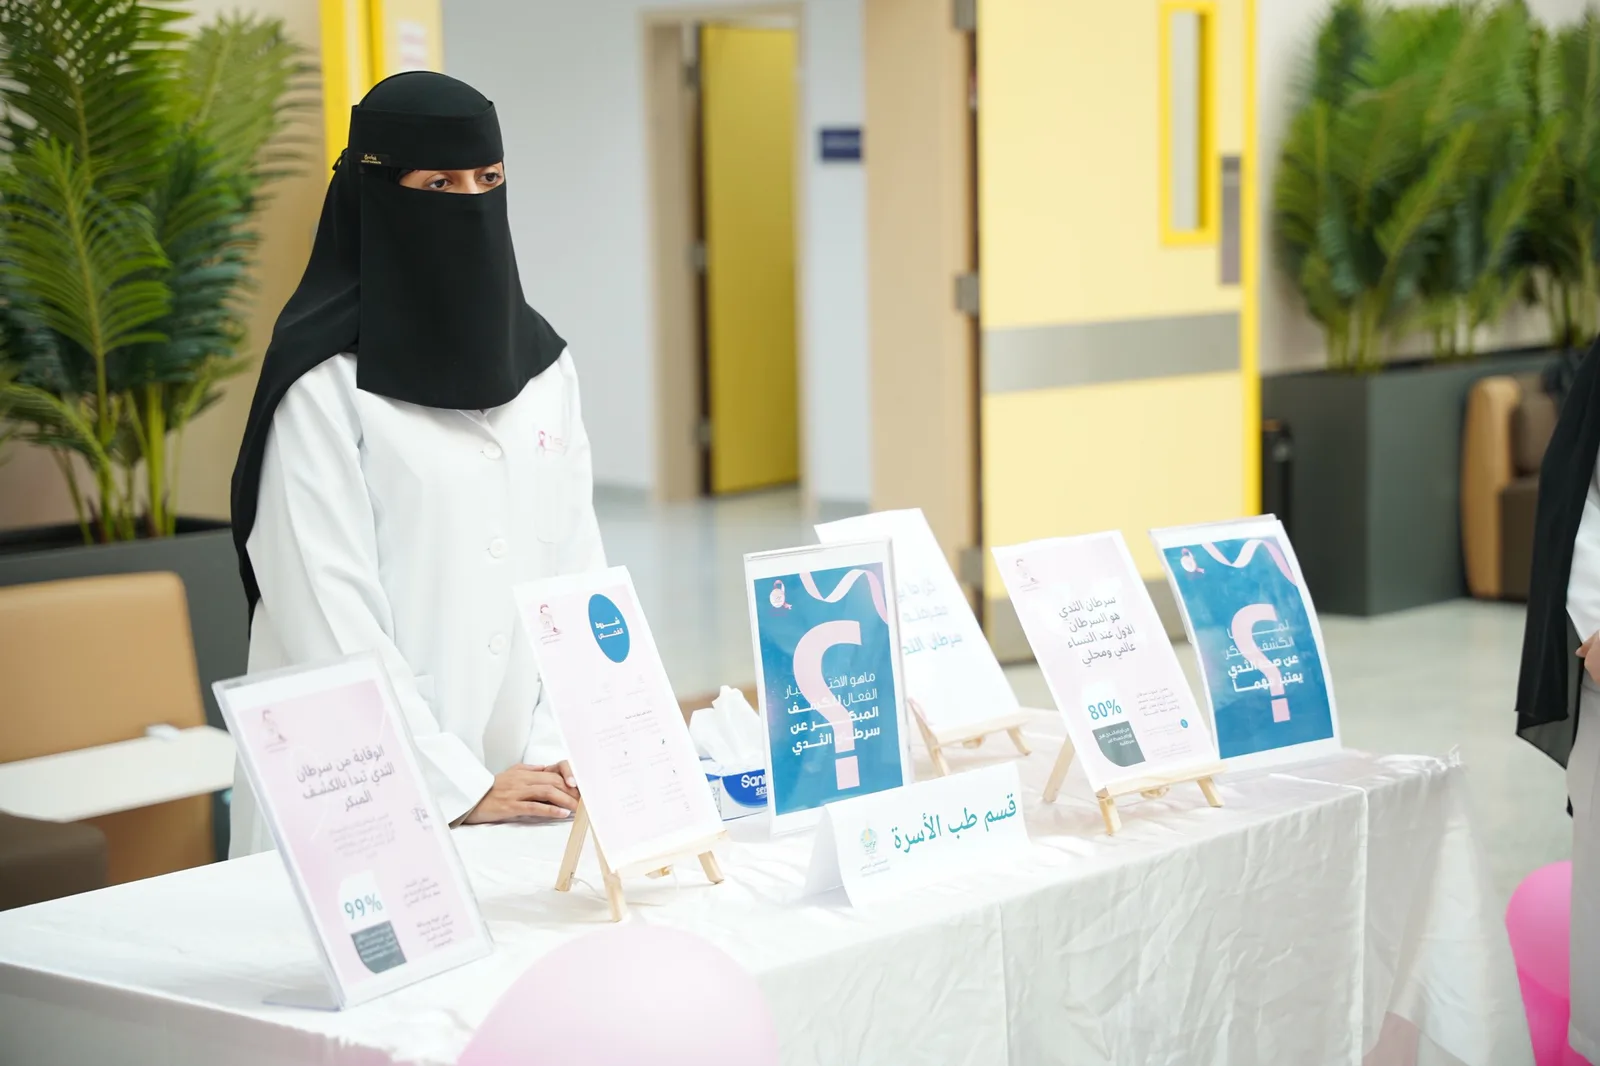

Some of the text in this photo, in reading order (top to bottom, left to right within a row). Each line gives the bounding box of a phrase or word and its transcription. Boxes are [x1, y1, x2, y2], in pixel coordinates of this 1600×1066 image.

[1058, 596, 1117, 621] سرطان الثدي
[1069, 612, 1121, 633] هو السرطان
[1067, 631, 1098, 649] النساء
[1099, 630, 1114, 640] عند
[1081, 641, 1137, 668] عالمي ومحلي
[1282, 654, 1300, 667] عن
[849, 671, 877, 688] ماهو
[1227, 659, 1258, 679] الثدي
[842, 688, 879, 707] الفعال
[1087, 698, 1122, 720] 80%
[790, 721, 808, 735] عن
[791, 732, 833, 756] الثدي
[296, 743, 385, 783] الوقاية من سرطان
[371, 761, 395, 787] الثدي
[345, 789, 374, 812] المبكر
[891, 793, 1017, 853] قسم طب الأسرة
[344, 893, 384, 920] 99%
